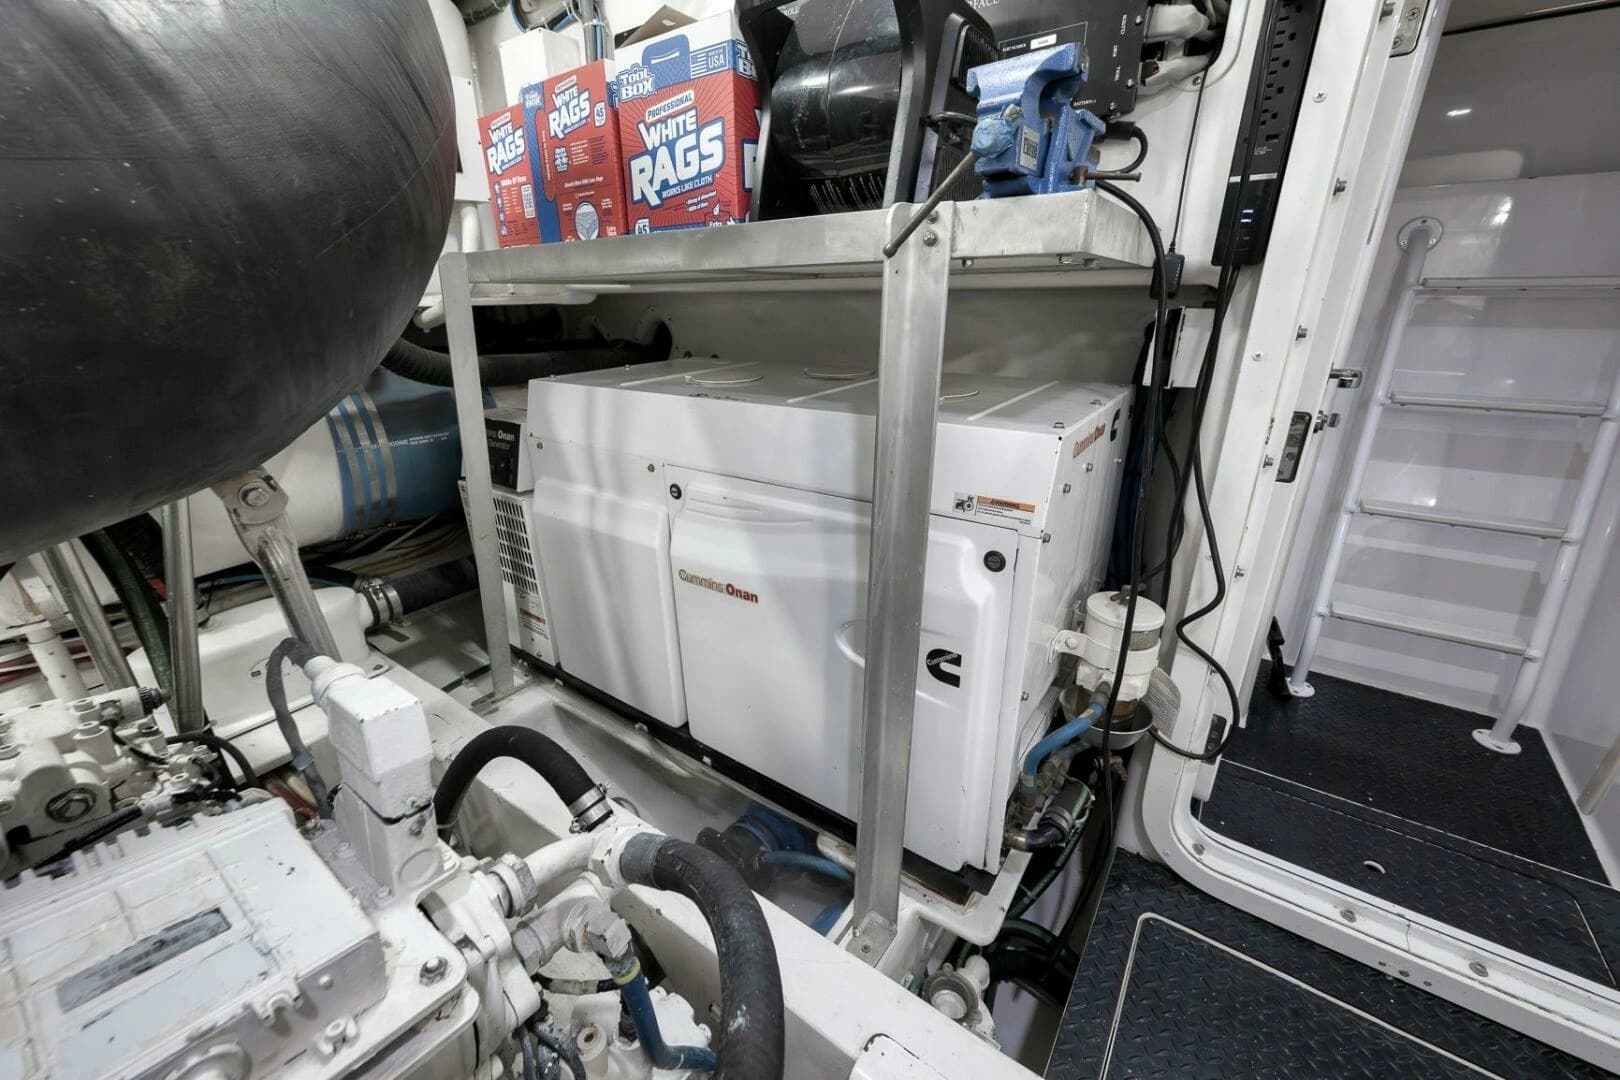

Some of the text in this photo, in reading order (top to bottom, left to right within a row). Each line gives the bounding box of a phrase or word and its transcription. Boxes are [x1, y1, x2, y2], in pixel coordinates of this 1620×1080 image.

[708, 54, 725, 68] USA
[620, 68, 651, 85] TOOL
[622, 77, 653, 100] BOX
[552, 85, 578, 107] WHITE
[647, 93, 693, 118] PROFESSIONAL
[548, 91, 591, 139] RAGS
[488, 122, 512, 145] WHITE
[638, 108, 697, 151] WHITE
[487, 128, 525, 175] RAGS
[630, 120, 723, 206] RAGS
[662, 175, 713, 198] WORKS LIKE CLOTH
[678, 568, 759, 604] Cummins Onan
